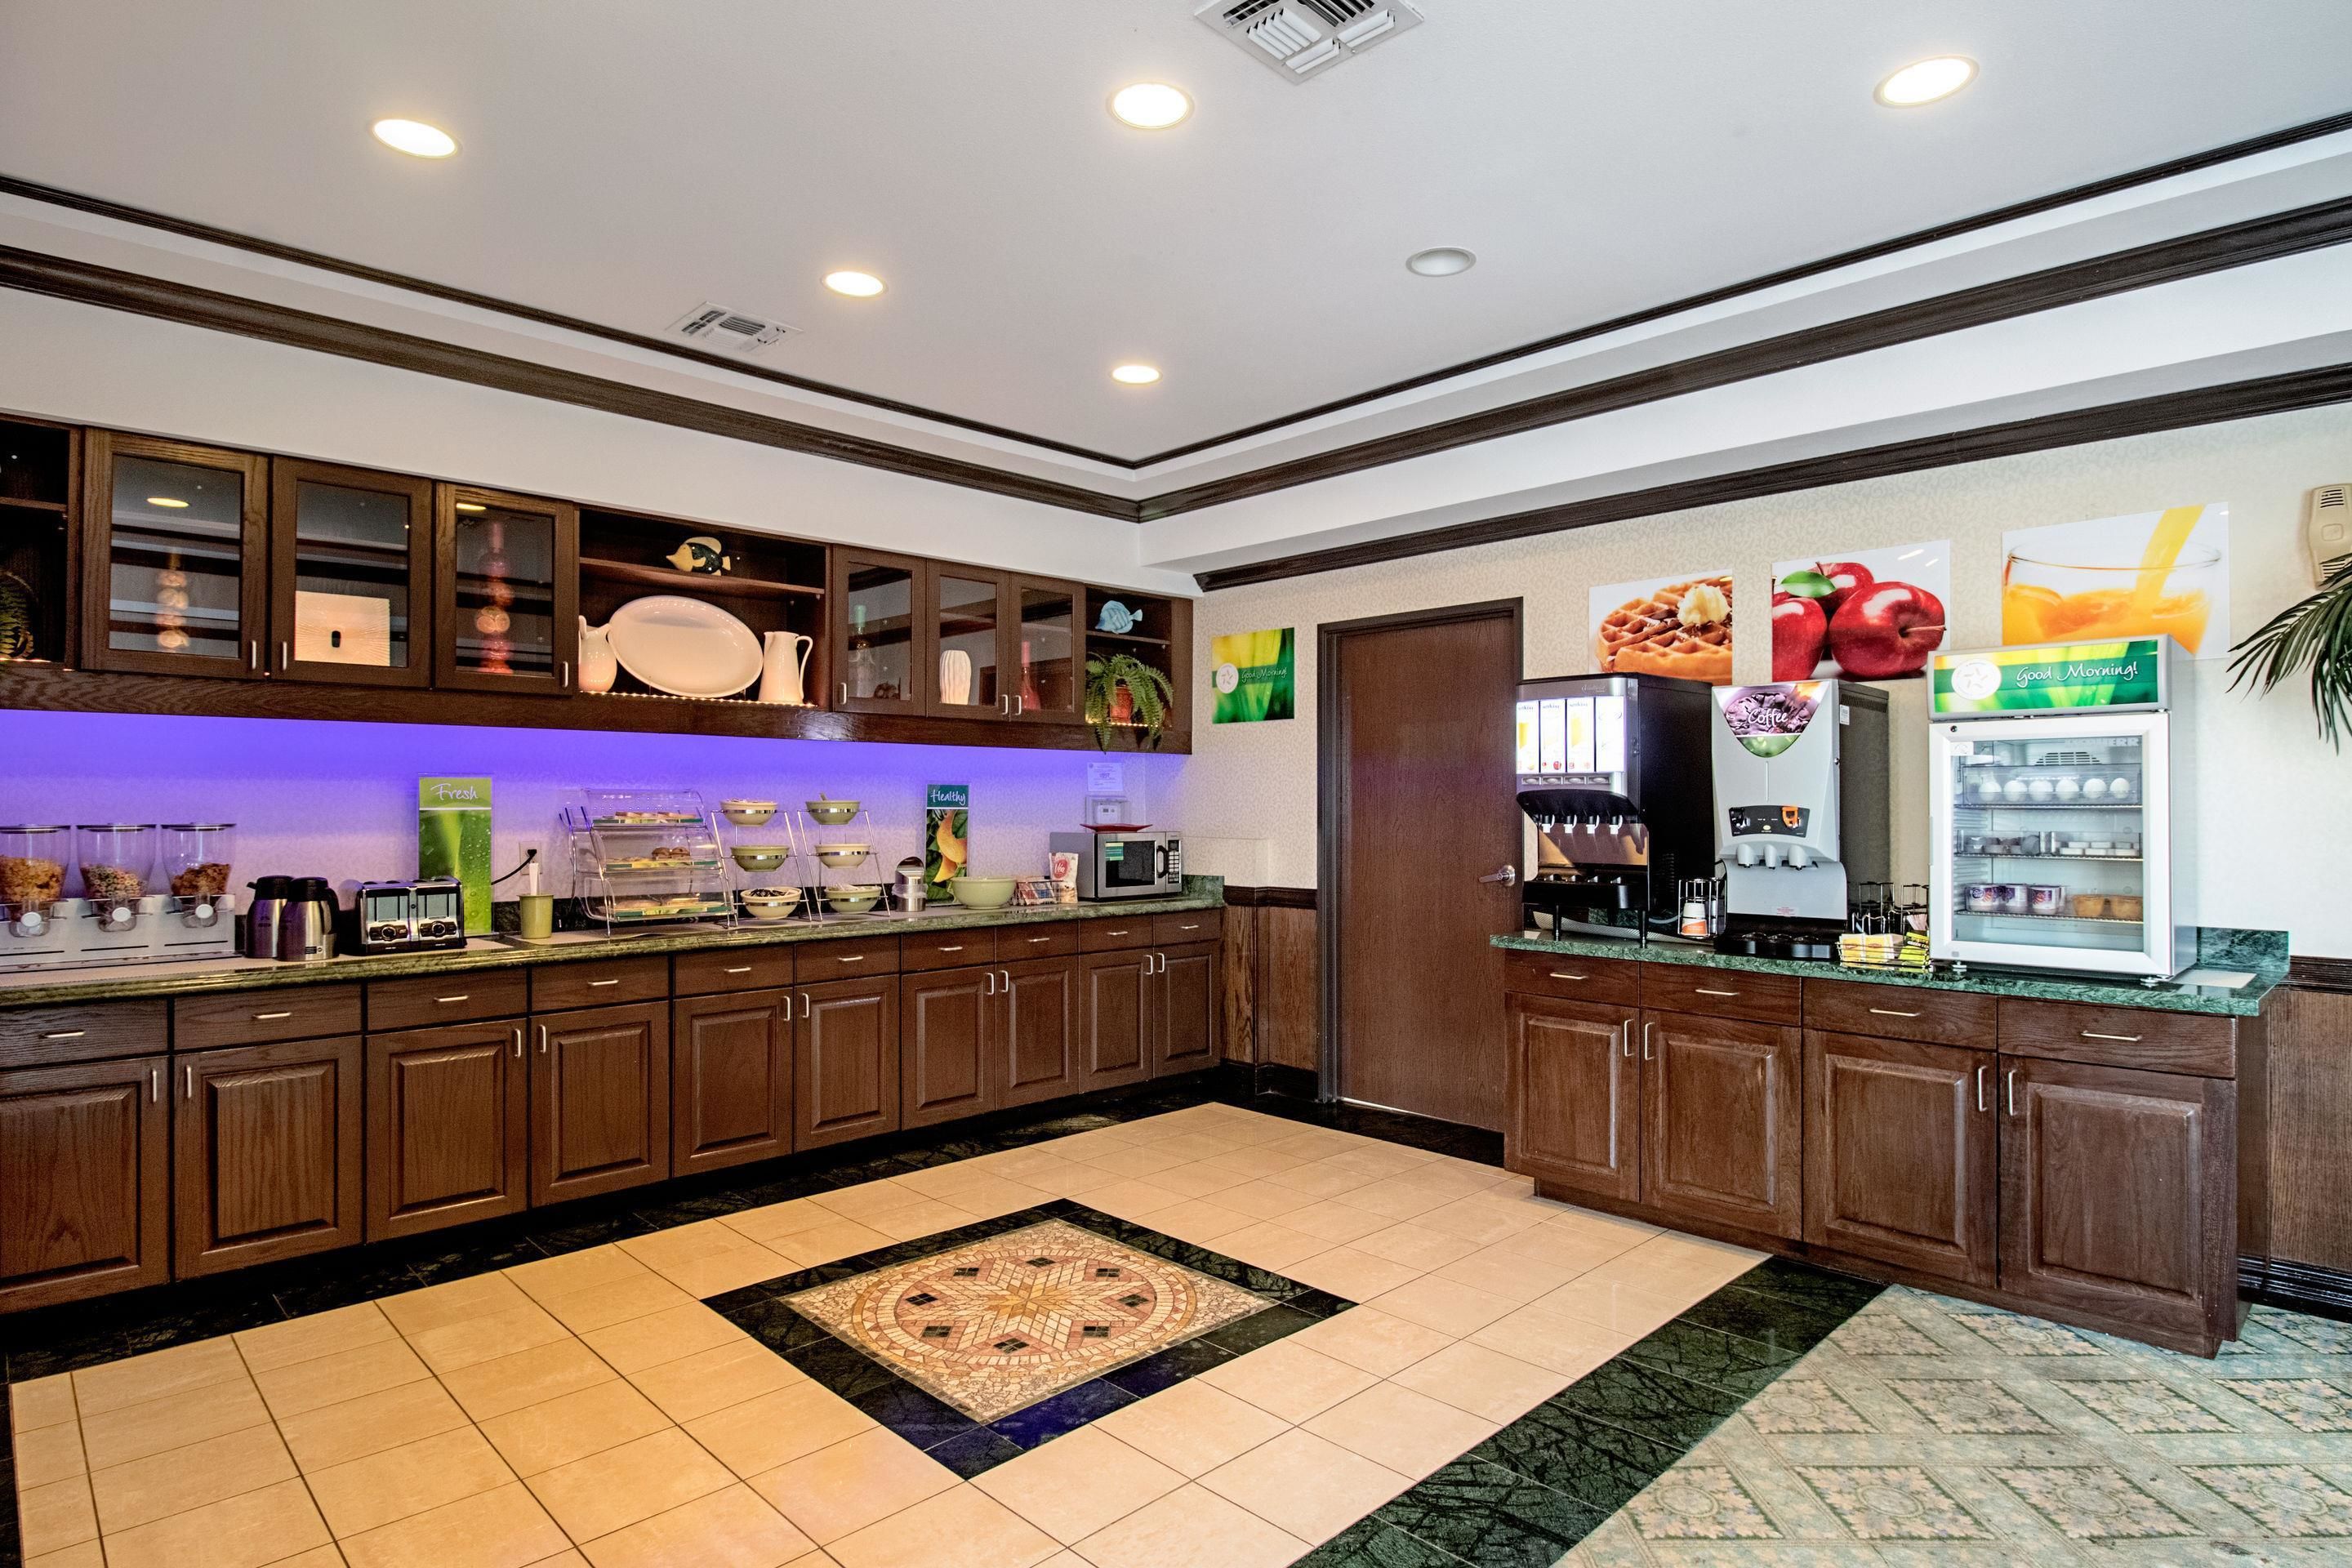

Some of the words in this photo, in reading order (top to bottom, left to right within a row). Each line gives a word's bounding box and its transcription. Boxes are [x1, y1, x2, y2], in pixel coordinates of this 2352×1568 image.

[1241, 670, 1256, 684] Good
[1257, 666, 1288, 679] Morning!
[2016, 666, 2052, 688] Good
[2056, 661, 2139, 681] Morning!
[1748, 708, 1788, 728] Coffee
[430, 782, 479, 801] Fresh
[930, 789, 966, 806] Healthy
